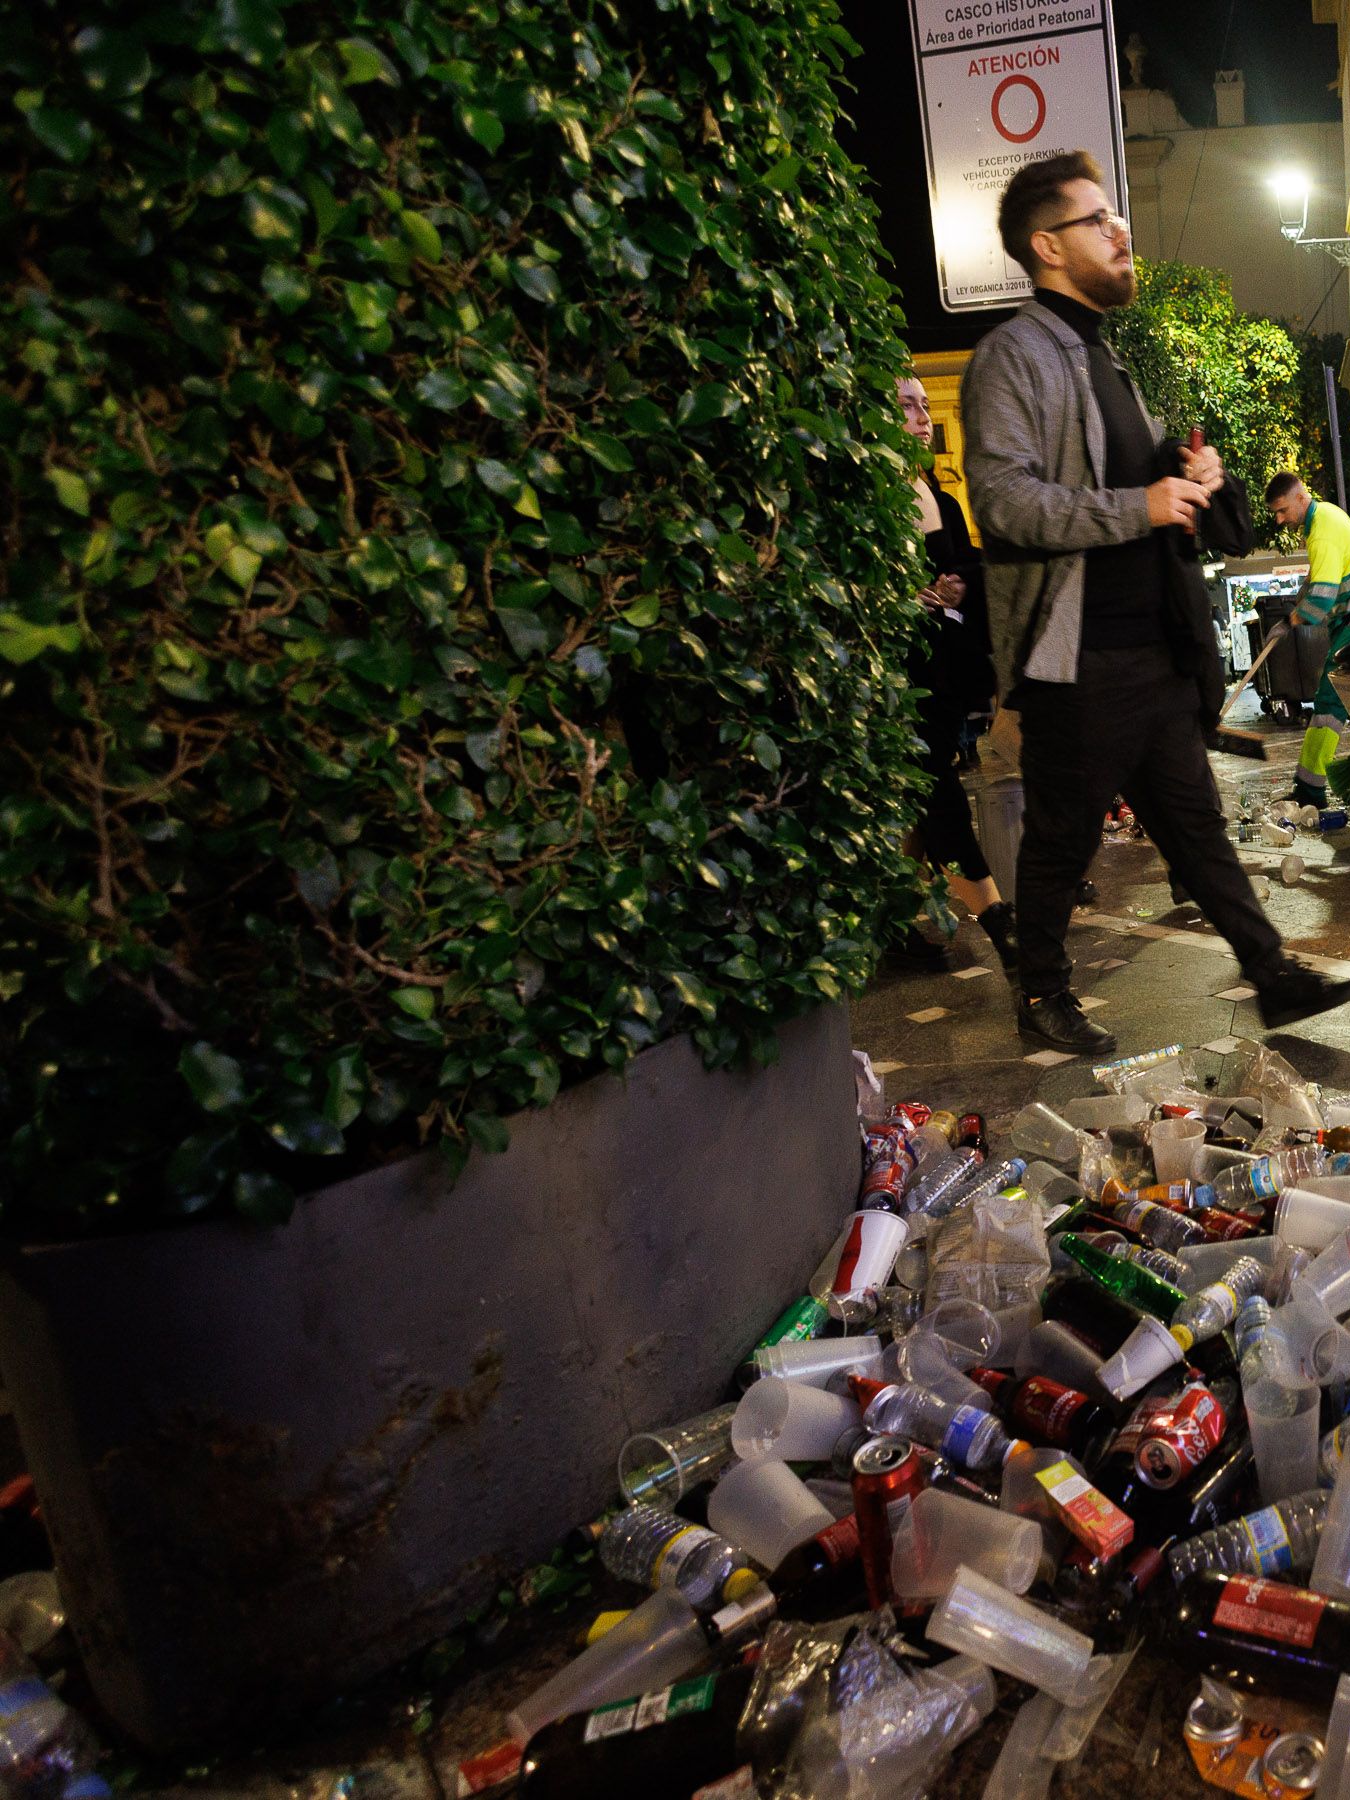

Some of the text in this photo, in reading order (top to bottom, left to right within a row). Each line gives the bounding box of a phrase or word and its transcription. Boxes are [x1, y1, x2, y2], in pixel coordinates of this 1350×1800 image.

[945, 4, 992, 23] CASCO
[926, 5, 1095, 45] Área de Prioridad Peatonal
[968, 45, 1060, 77] ATENCIÓN
[978, 153, 1021, 167] EXCEPTO
[956, 287, 968, 296] LEY
[1005, 281, 1026, 291] 3/2018
